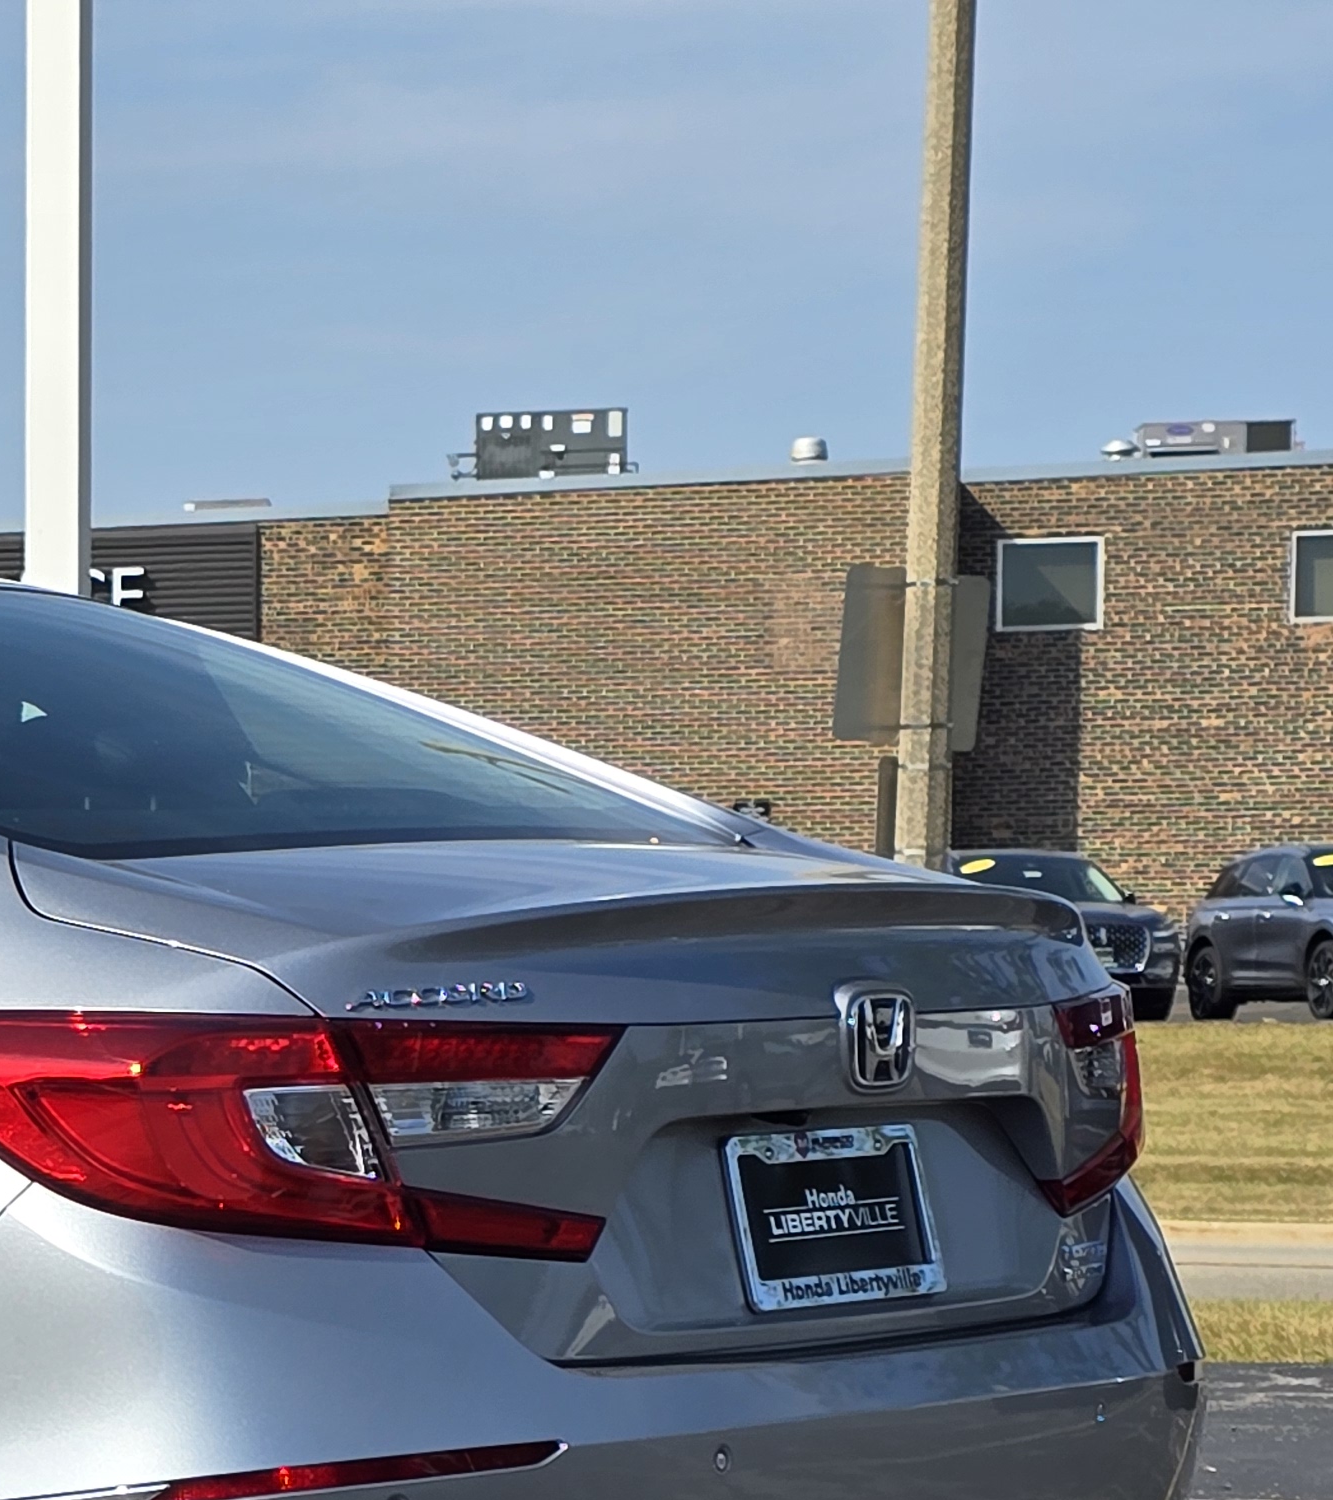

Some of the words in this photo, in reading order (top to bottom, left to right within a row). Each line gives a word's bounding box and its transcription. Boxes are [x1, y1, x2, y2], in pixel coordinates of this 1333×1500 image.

[345, 981, 530, 1012] ACCORD
[804, 1184, 856, 1209] Honda
[769, 1203, 900, 1236] LIBERTYVILLE
[782, 1275, 834, 1301] Honda
[836, 1267, 923, 1297] Libertyville
